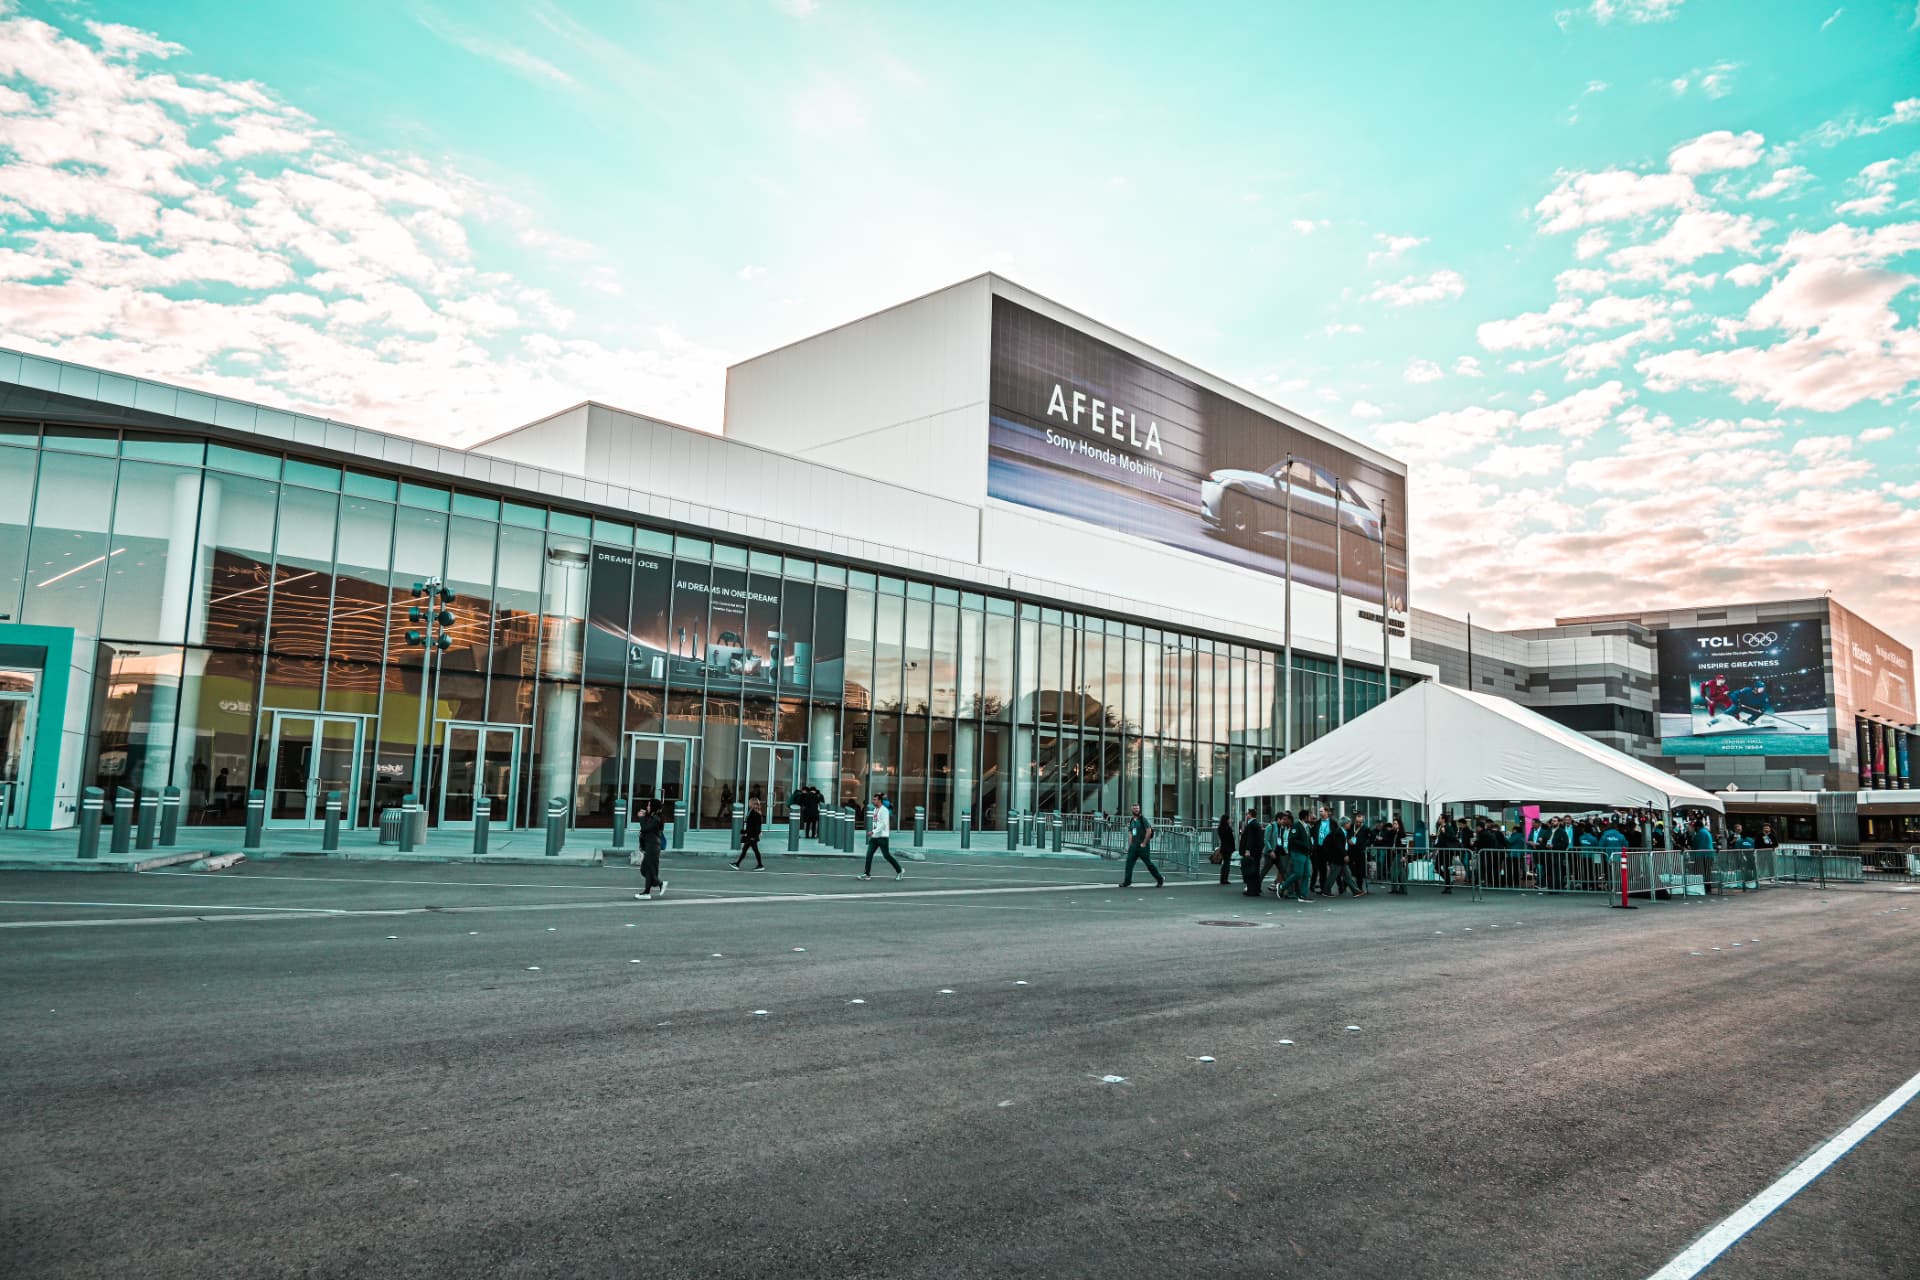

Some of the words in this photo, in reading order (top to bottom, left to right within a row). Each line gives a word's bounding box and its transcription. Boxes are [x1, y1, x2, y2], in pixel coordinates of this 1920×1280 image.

[1047, 383, 1163, 456] AFEELA
[1046, 428, 1076, 454] Sony
[1079, 440, 1116, 465] Honda
[1119, 454, 1163, 483] Mobility
[688, 582, 720, 594] DREAMS
[721, 588, 730, 597] IN
[730, 589, 747, 599] ONE
[747, 591, 779, 604] DREAME
[1697, 636, 1734, 648] TCL
[1698, 662, 1729, 670] INSPIRE
[1730, 659, 1780, 669] GREATNESS
